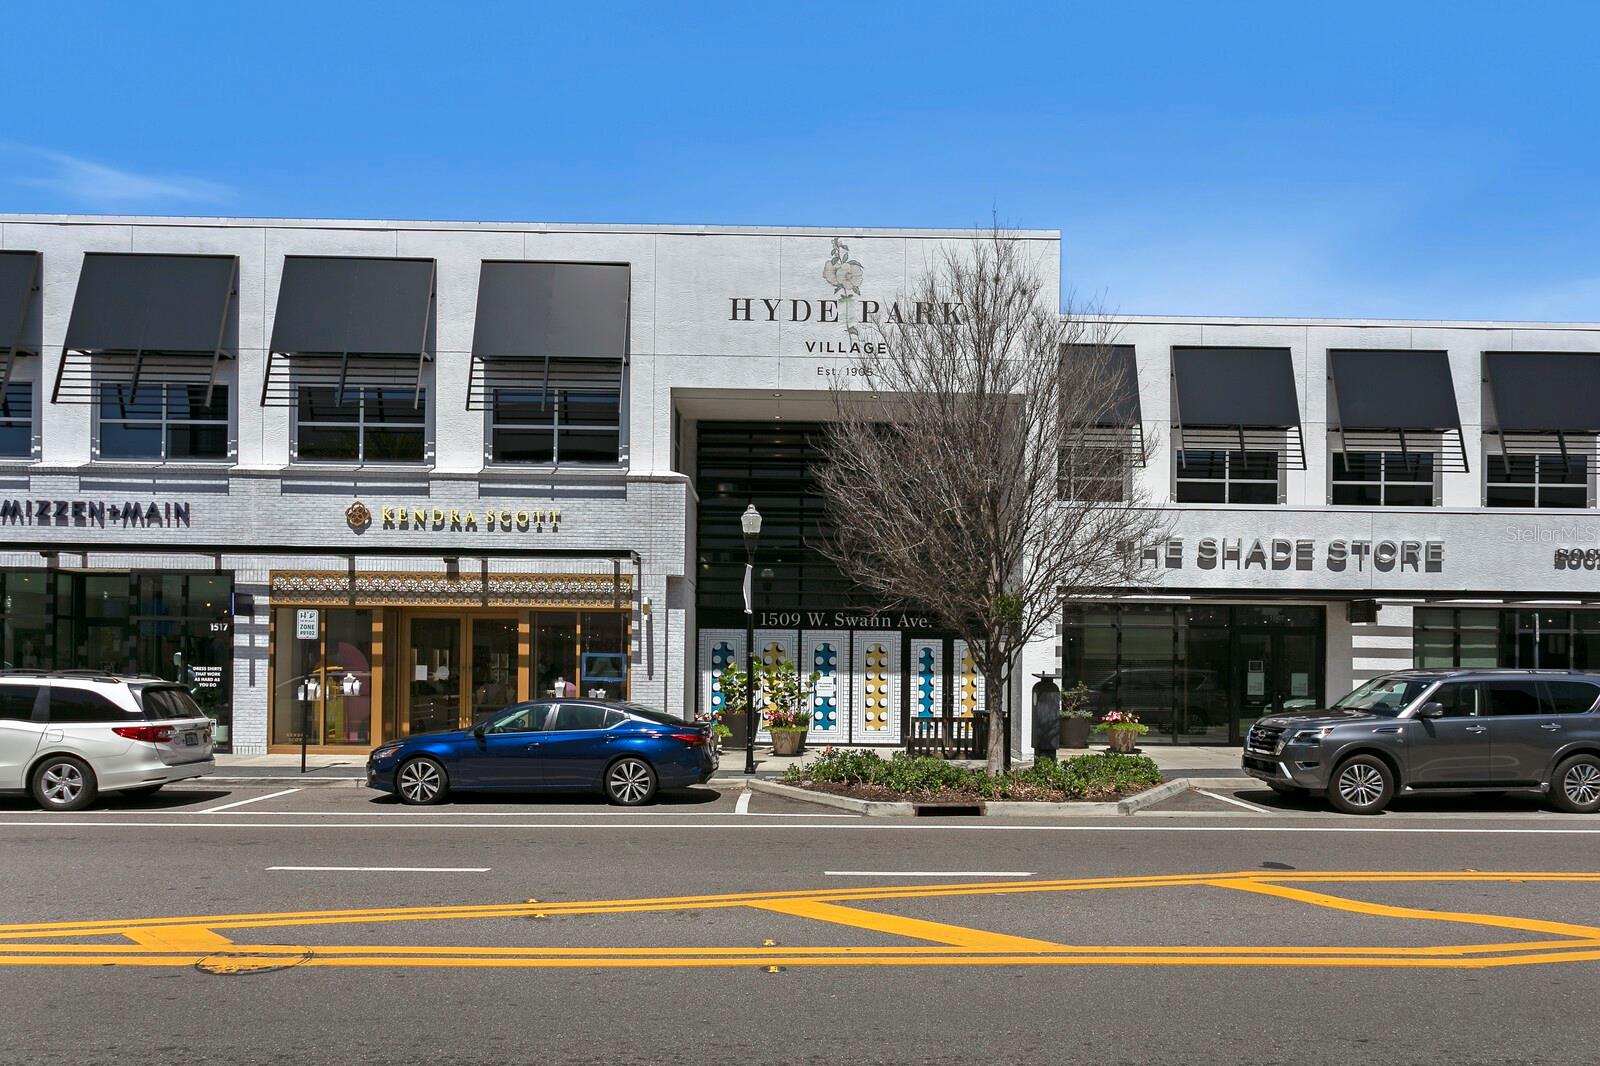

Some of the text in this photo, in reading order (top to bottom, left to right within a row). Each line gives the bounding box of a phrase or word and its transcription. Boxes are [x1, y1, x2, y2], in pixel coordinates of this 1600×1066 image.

[728, 297, 964, 325] HYDE PARK
[804, 340, 888, 355] VILLAGE
[382, 505, 562, 529] KENDRA SCOTT
[1197, 536, 1316, 567] SHADE
[1327, 538, 1445, 570] STORE
[209, 622, 229, 632] 1517
[760, 611, 933, 629] 1509 W. Swann Ave.
